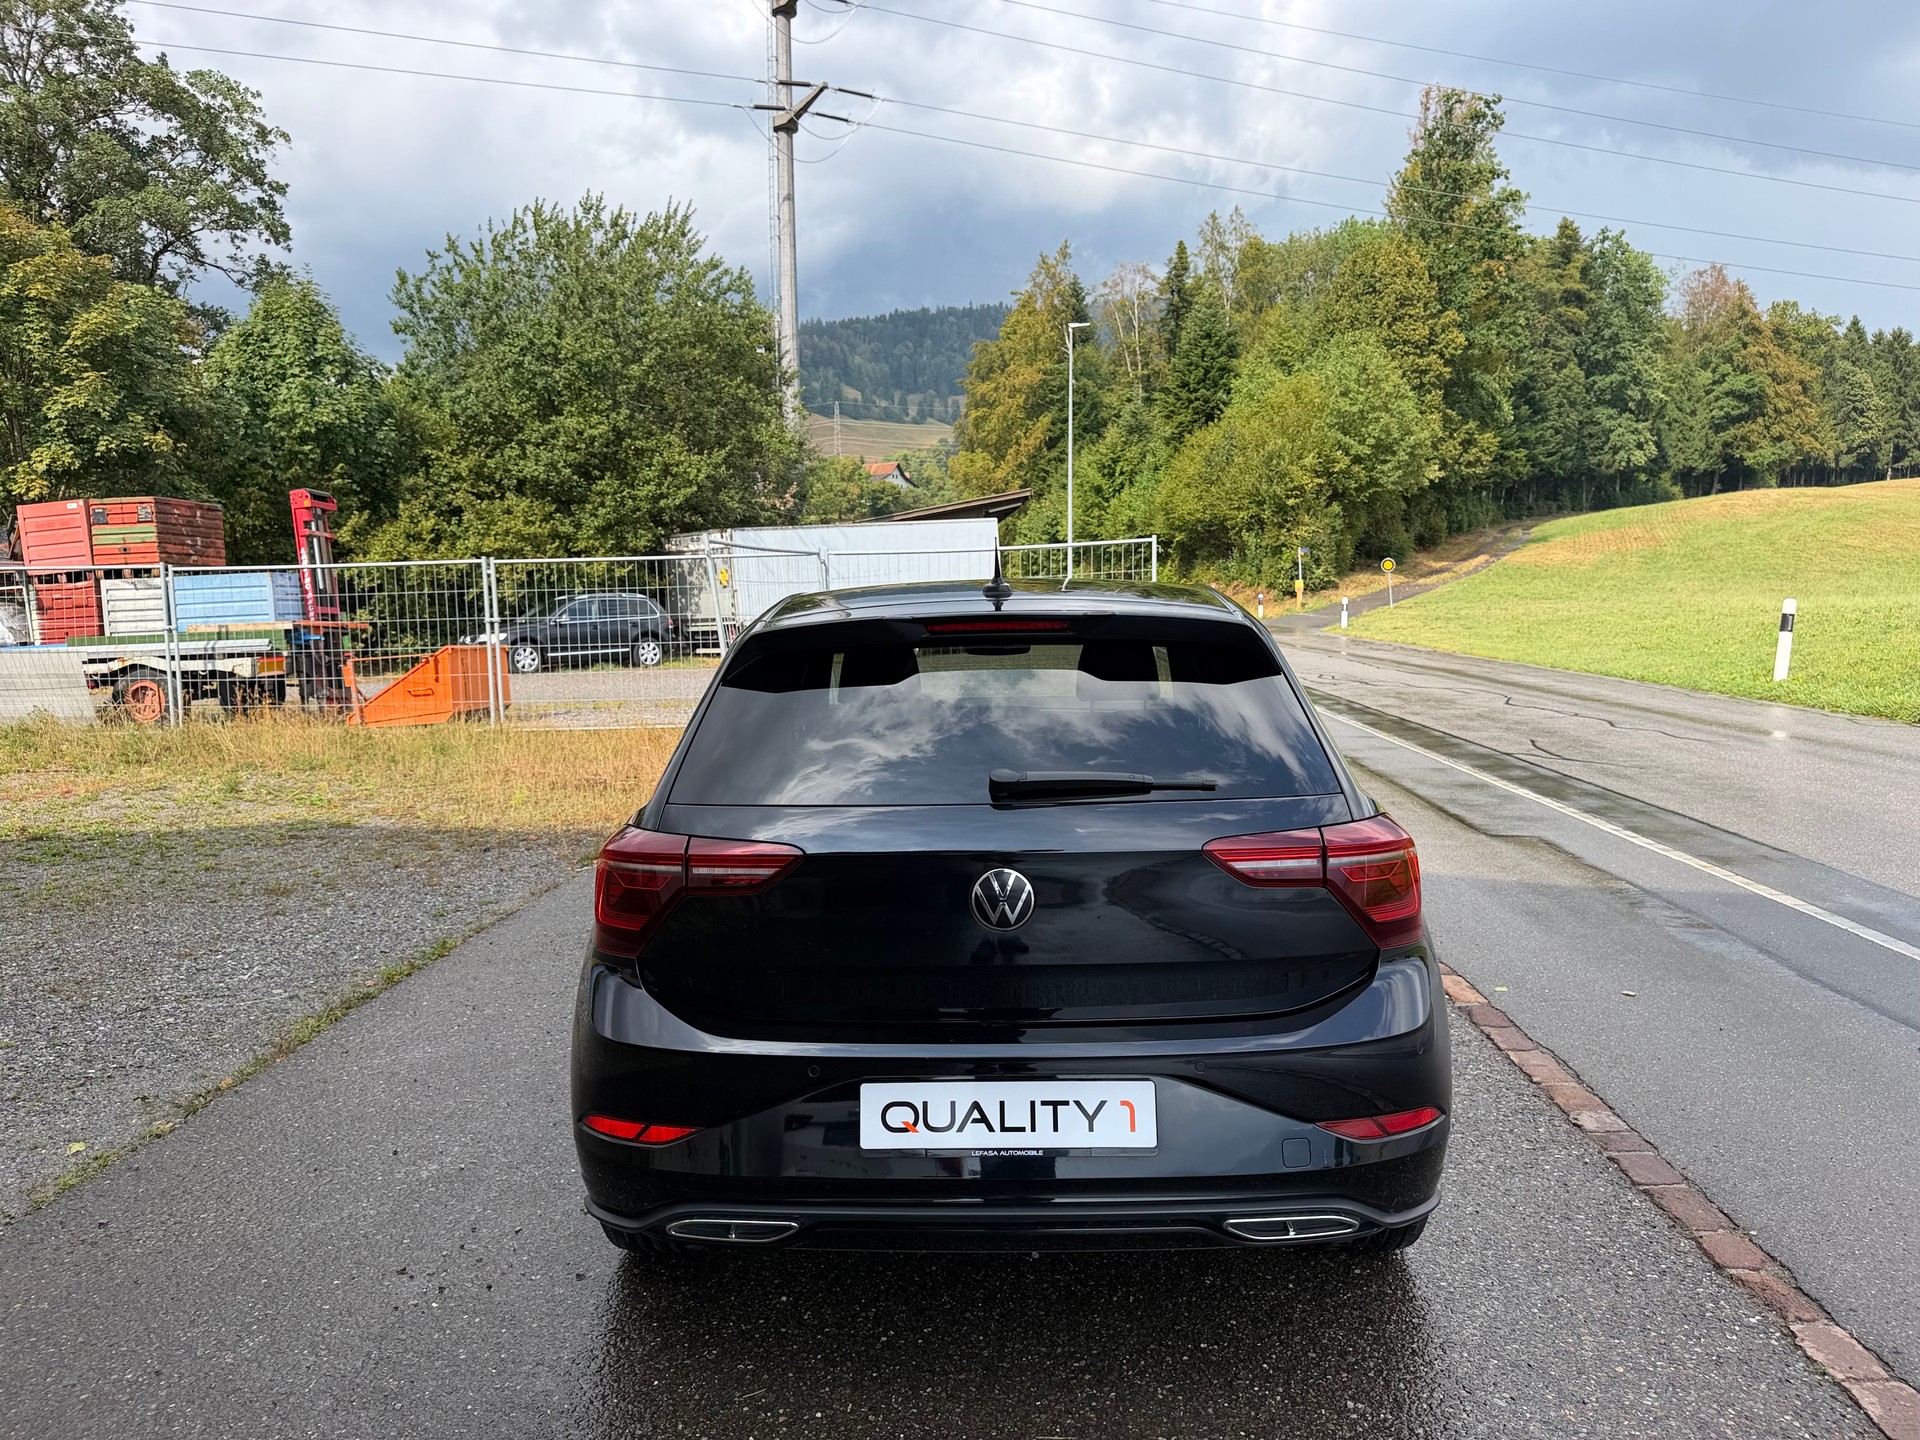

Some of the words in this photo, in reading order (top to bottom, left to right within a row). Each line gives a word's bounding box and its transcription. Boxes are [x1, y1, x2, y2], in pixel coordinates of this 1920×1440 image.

[972, 869, 1034, 930] VW
[881, 1100, 1108, 1133] QUALITY
[1119, 1100, 1136, 1132] 1
